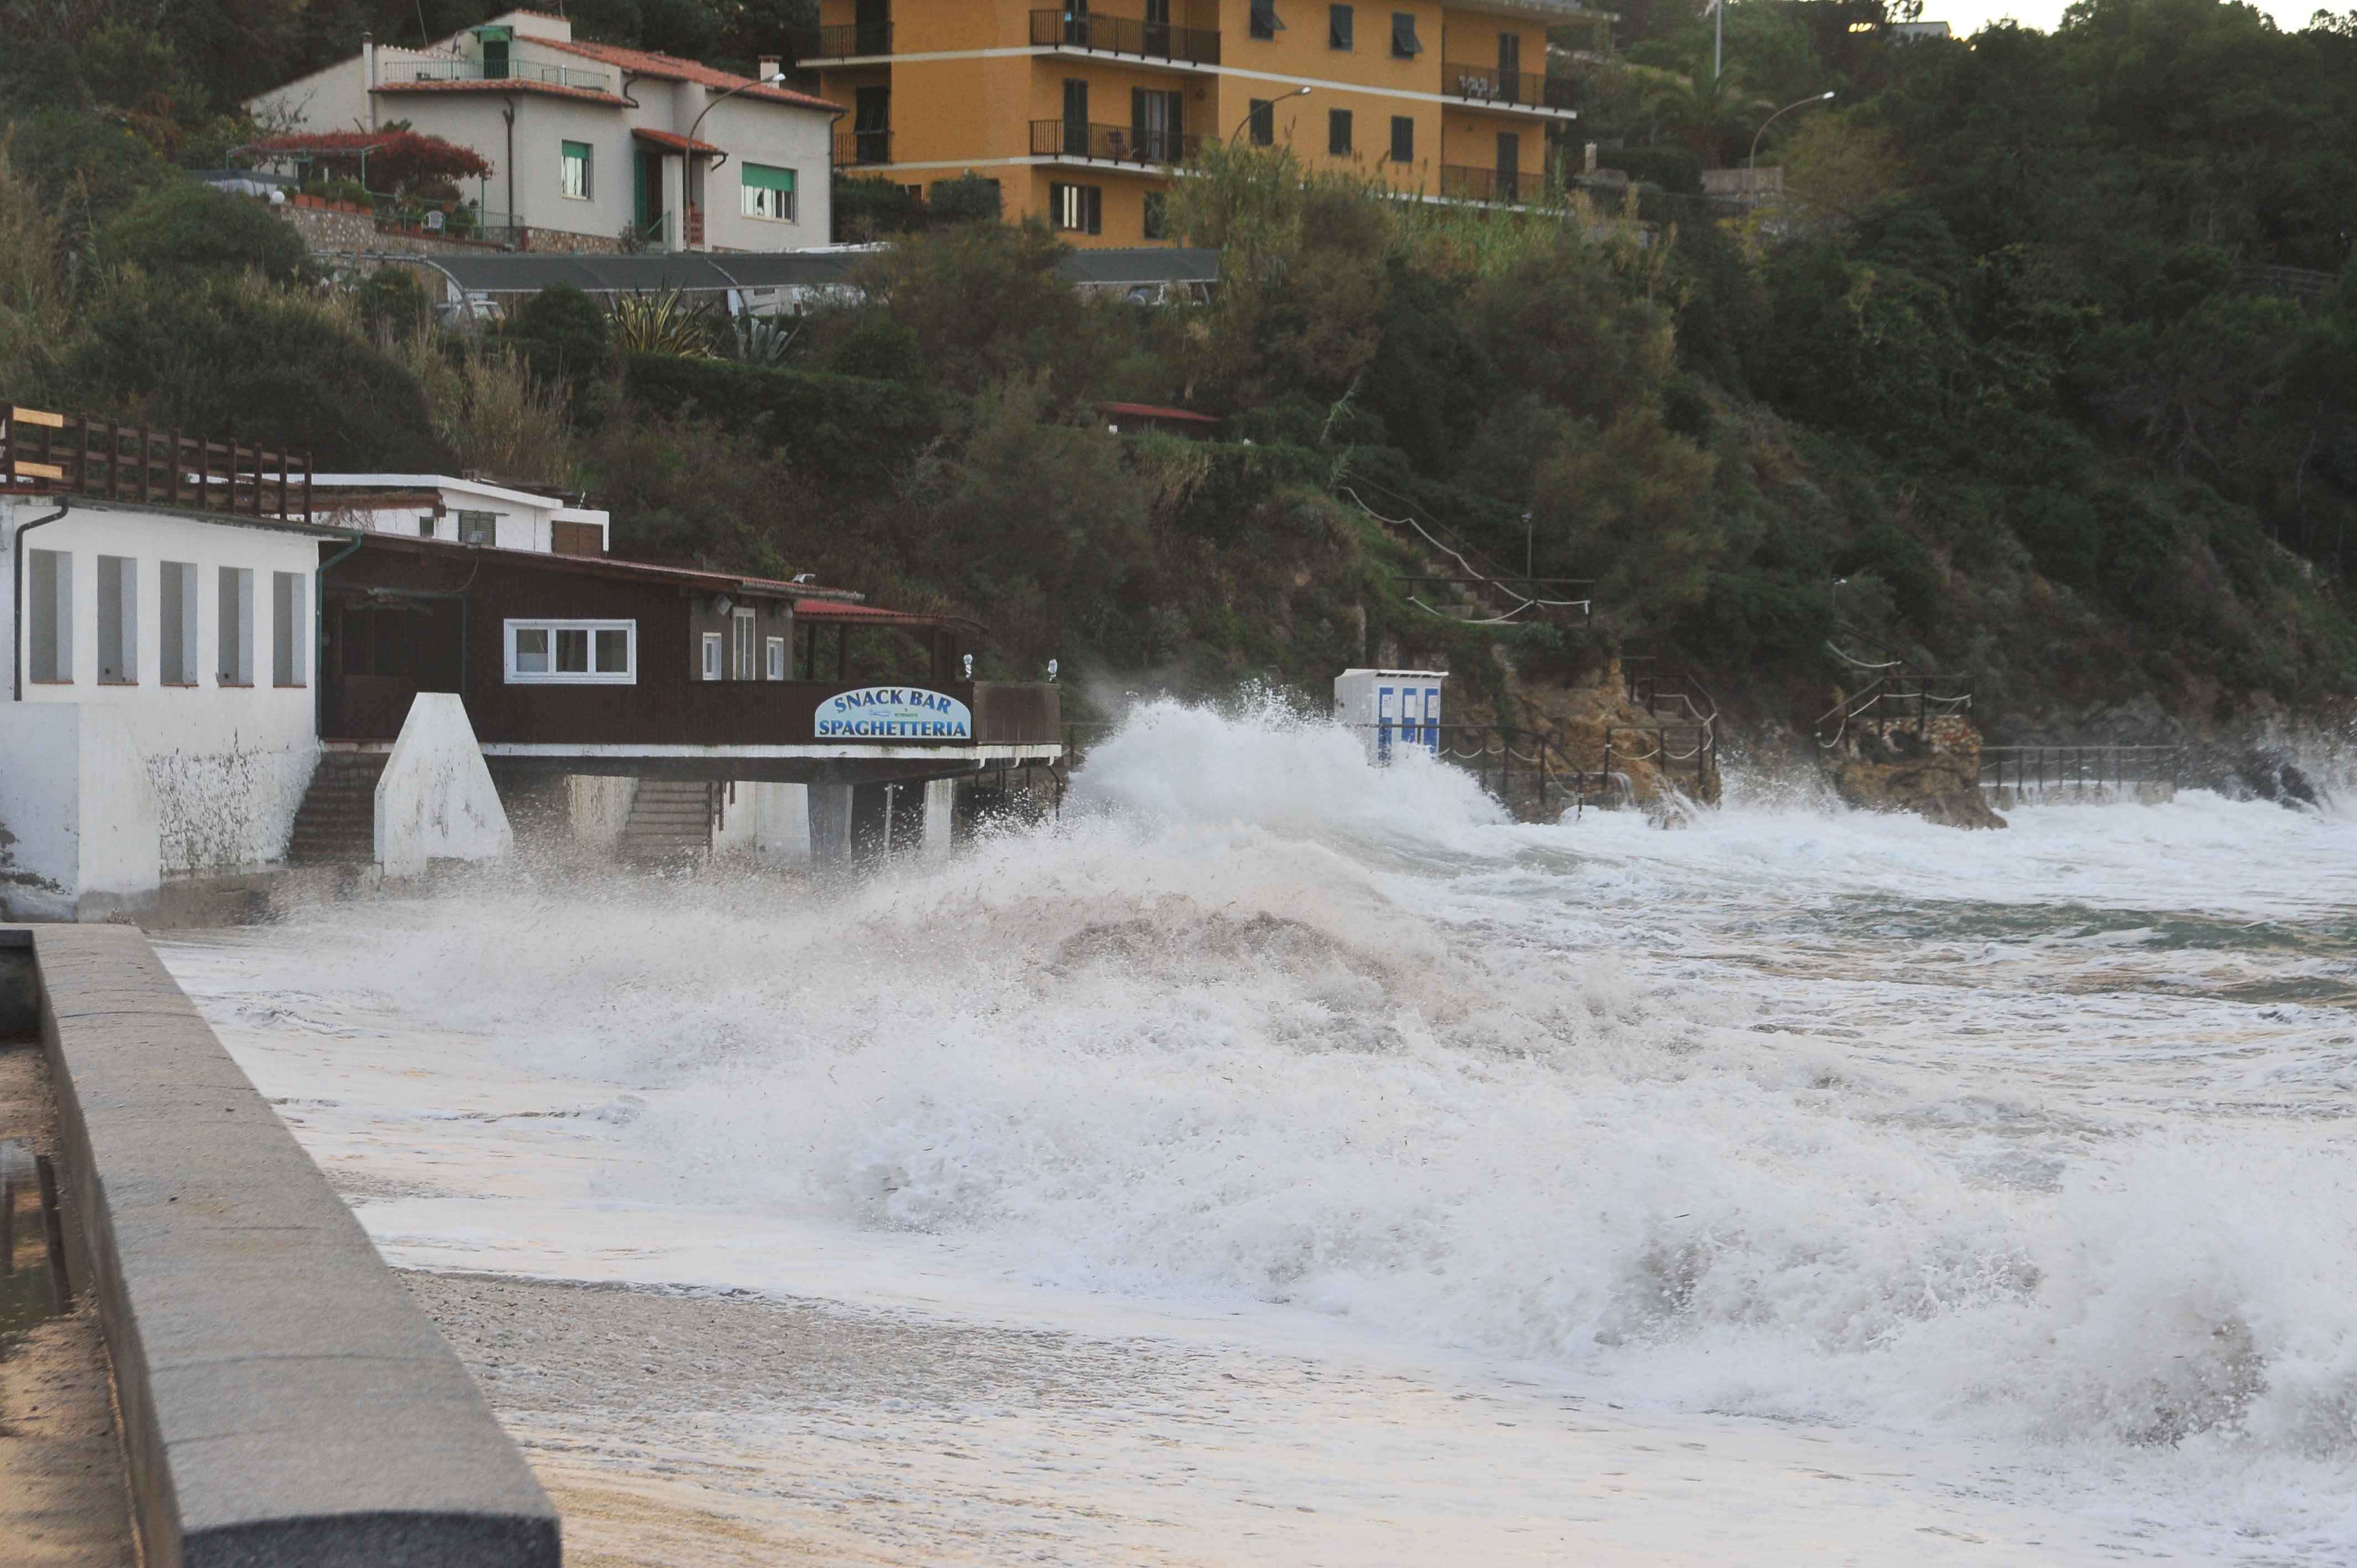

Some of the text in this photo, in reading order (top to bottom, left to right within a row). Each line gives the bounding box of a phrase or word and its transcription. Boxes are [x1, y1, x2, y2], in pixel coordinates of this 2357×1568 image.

[835, 689, 951, 714] SNACK BAR
[819, 720, 966, 736] SPAGHETTERIA
